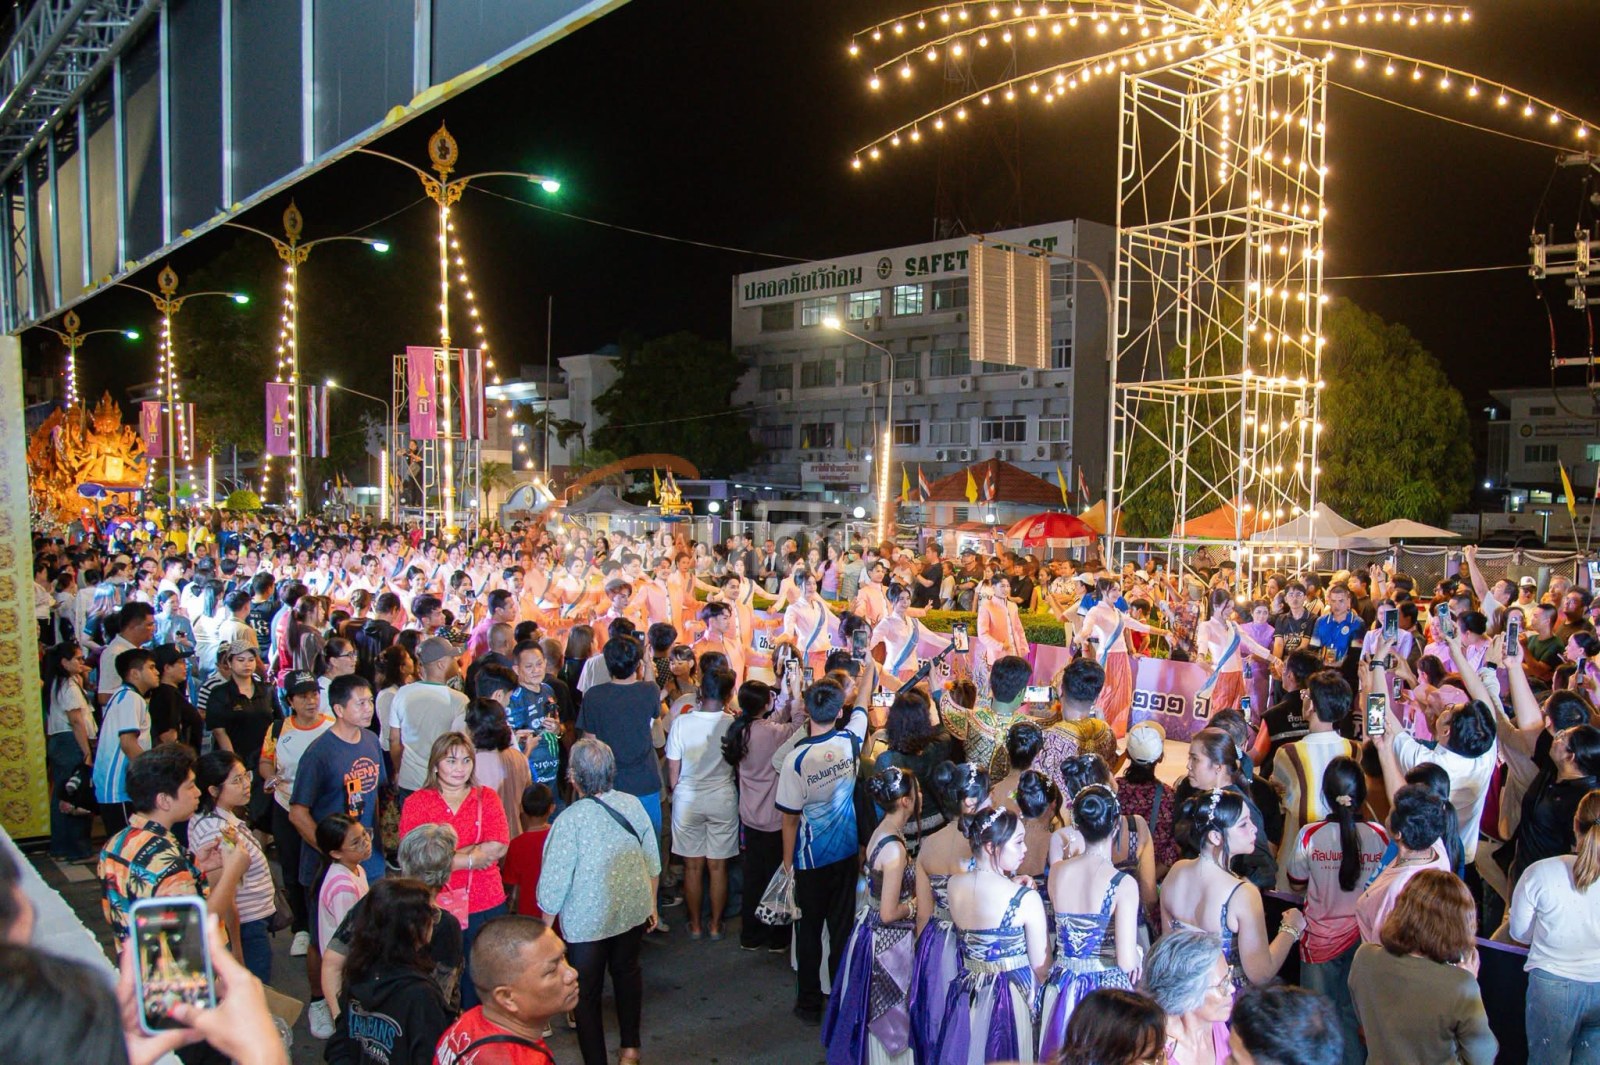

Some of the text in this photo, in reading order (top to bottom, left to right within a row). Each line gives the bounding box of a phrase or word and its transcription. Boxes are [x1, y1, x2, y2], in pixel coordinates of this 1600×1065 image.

[905, 250, 969, 277] SAFET
[744, 264, 863, 301] ปลอดภัยไว้ก่อน
